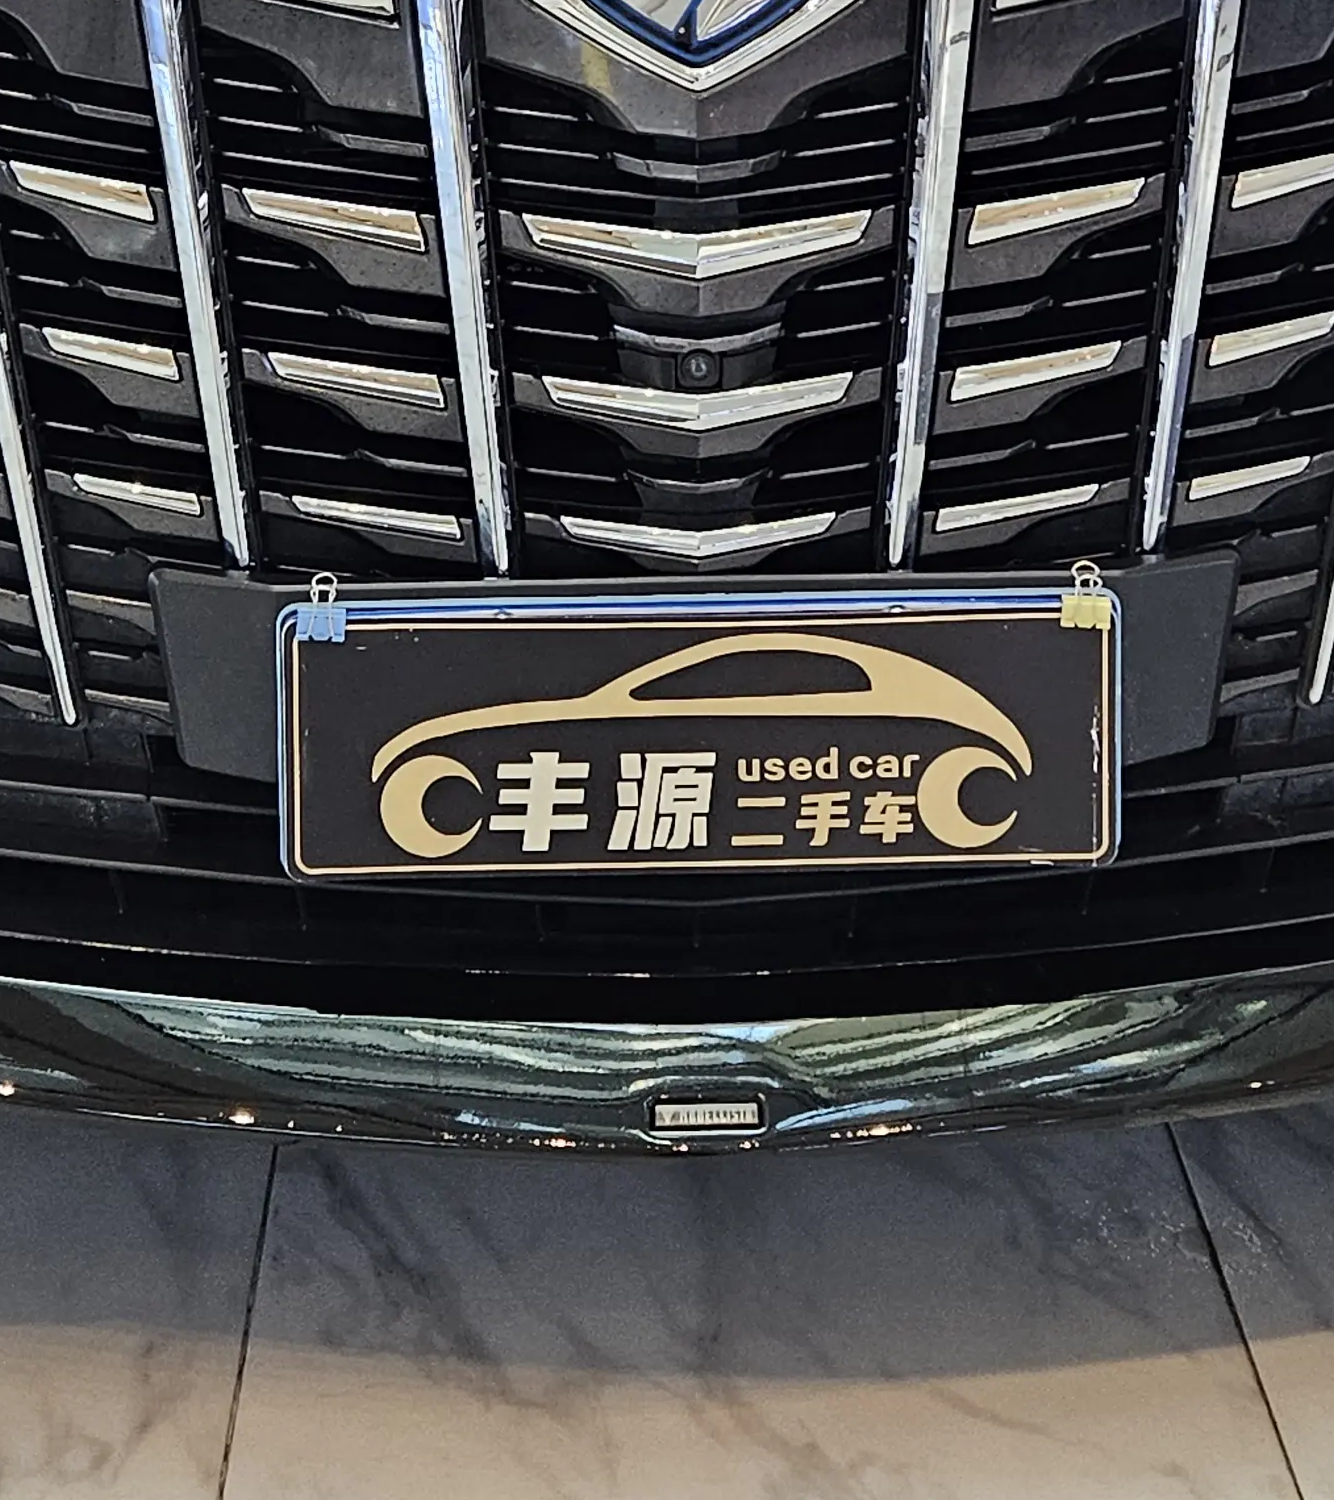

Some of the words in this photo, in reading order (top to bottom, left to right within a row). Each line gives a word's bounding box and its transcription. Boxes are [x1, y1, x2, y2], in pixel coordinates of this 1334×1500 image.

[737, 747, 839, 782] used
[849, 753, 920, 779] car
[489, 752, 716, 852] 丰源
[731, 791, 917, 847] 二手车
